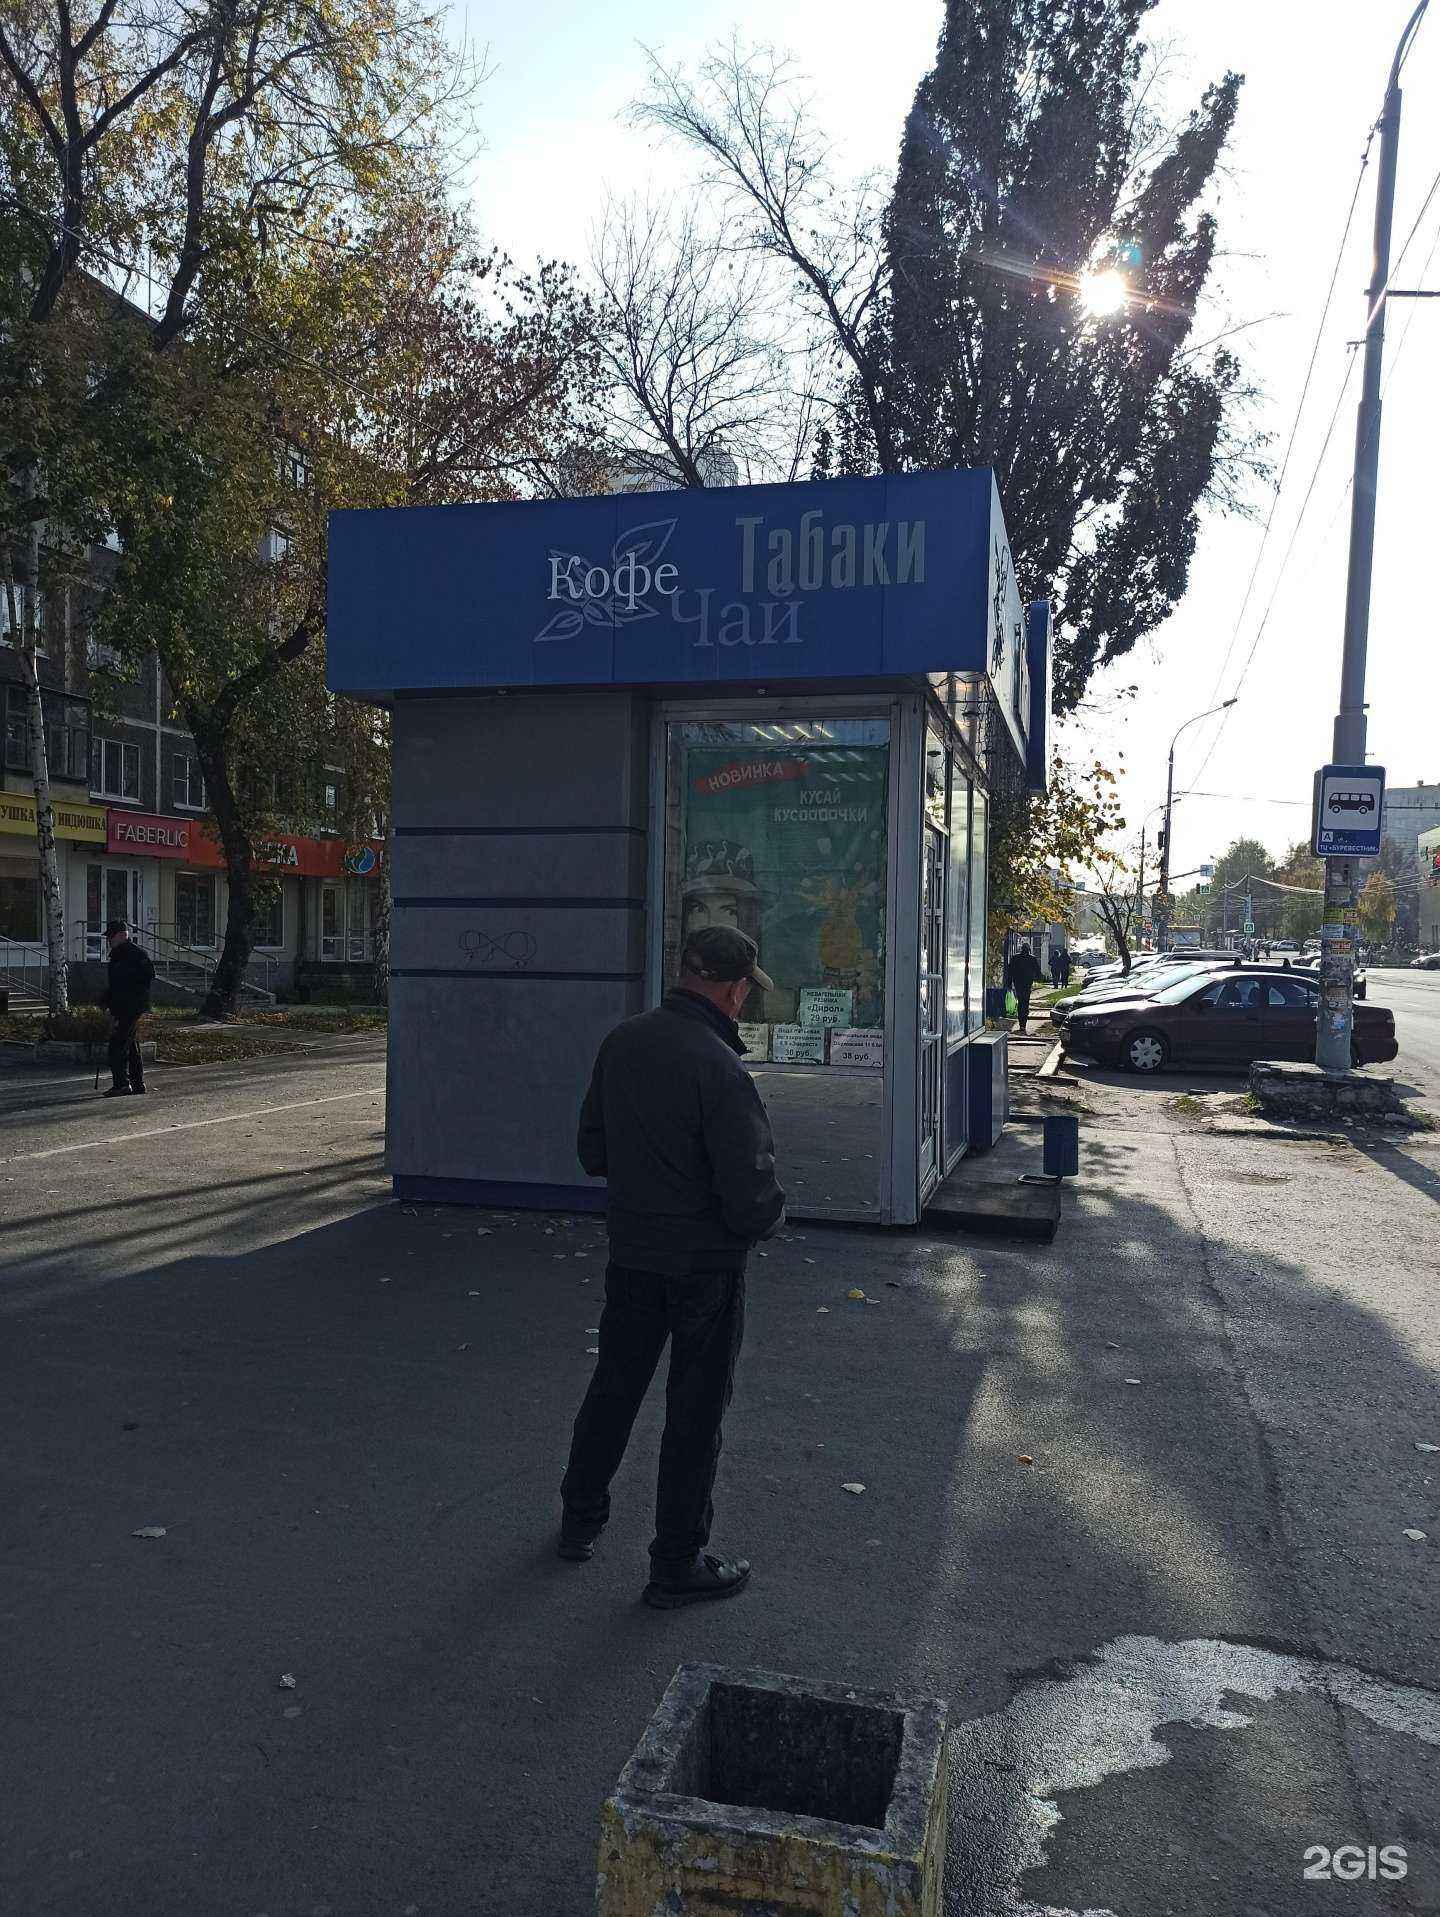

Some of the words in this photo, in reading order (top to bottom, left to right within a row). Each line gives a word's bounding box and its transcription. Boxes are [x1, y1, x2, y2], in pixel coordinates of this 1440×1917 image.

[735, 509, 927, 594] Табаки
[547, 552, 679, 610] Кофе
[671, 581, 805, 647] Чай
[708, 761, 784, 790] НОВИНКА
[800, 787, 841, 804] КУСАЙ
[116, 823, 189, 848] FABERLIC
[822, 1014, 841, 1024] руб.
[854, 1053, 872, 1062] руб.
